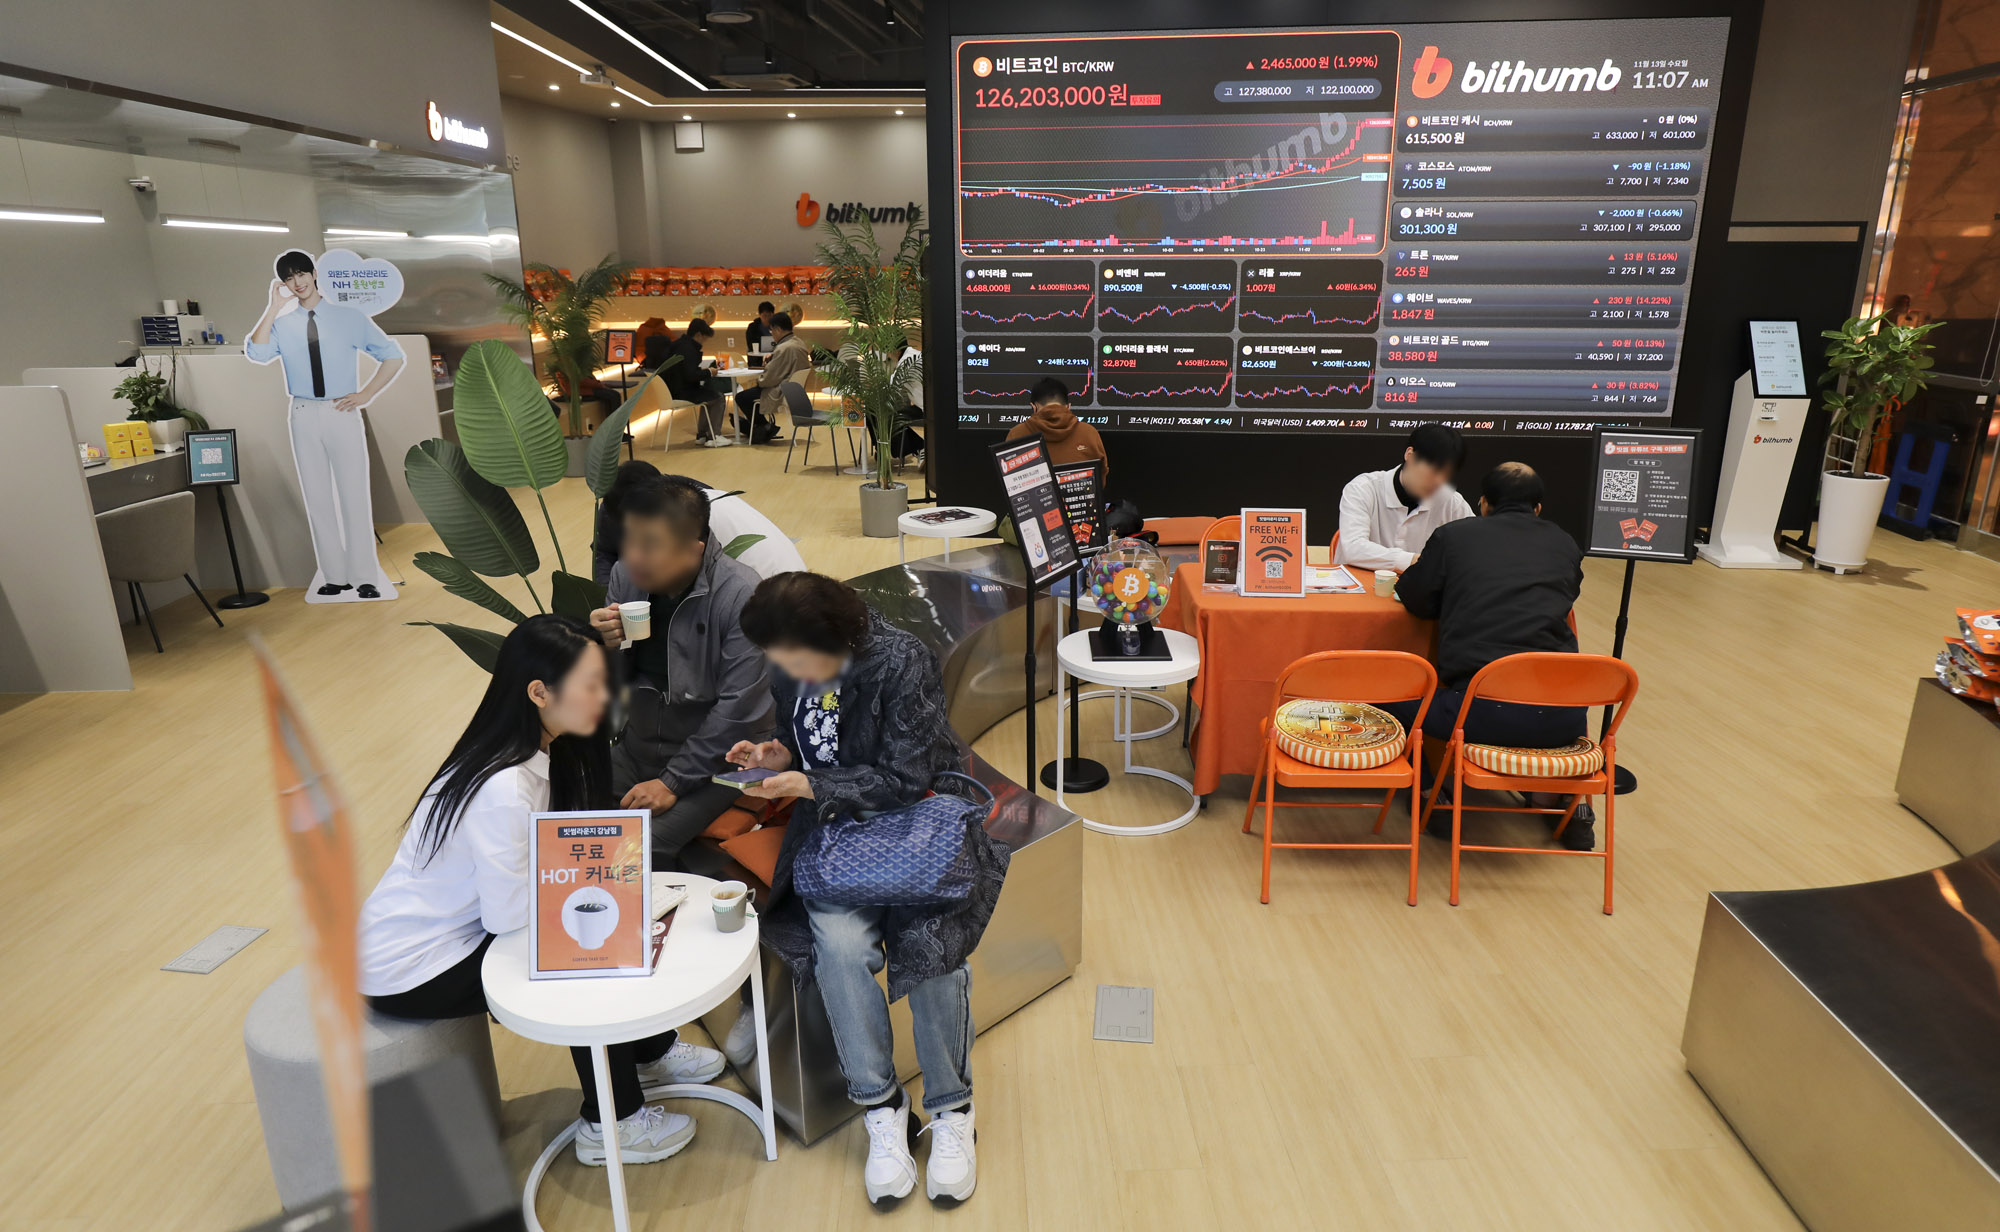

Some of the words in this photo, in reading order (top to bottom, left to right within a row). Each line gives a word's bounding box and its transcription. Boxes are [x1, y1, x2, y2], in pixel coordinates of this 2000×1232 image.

[997, 56, 1057, 75] 비트코인
[1063, 61, 1114, 73] BTC/KRW
[1261, 58, 1317, 69] 2,465,000
[1334, 55, 1378, 69] (1.99%)
[1461, 59, 1621, 93] bithumb
[1633, 72, 1689, 88] 11:07
[1692, 79, 1708, 88] AM
[1239, 87, 1291, 96] 127,380,000
[1306, 86, 1314, 95] 저
[1321, 85, 1374, 94] 122,100,000
[976, 86, 1105, 108] 126,203,000
[1422, 115, 1459, 126] 비트코인
[1461, 115, 1480, 125] 캐시
[1678, 115, 1697, 124] (0%)
[1406, 133, 1452, 144] 615,500
[1649, 131, 1657, 139] 저
[1663, 131, 1695, 139] 601,000
[1418, 162, 1454, 170] 코스모스
[1655, 162, 1690, 171] (-1.18%)
[1403, 179, 1433, 189] 7,505
[1653, 177, 1660, 185] 저
[1667, 177, 1689, 185] 7,340
[826, 202, 921, 224] bithumb
[1415, 207, 1443, 217] 솔라나
[1648, 209, 1682, 217] (-0.66%)
[1400, 224, 1445, 234] 301,300
[1410, 250, 1428, 260] 트론
[1647, 253, 1677, 261] (5.16%)
[351, 270, 388, 278] 자산관리도
[978, 269, 1007, 278] 이더리움
[1259, 268, 1274, 277] 리플
[1395, 267, 1416, 276] 265
[352, 280, 385, 289] 올원뱅크
[967, 284, 1010, 292] 4,688,000원
[1104, 284, 1142, 292] 890,500원
[1247, 284, 1275, 292] 1,007원
[1407, 293, 1433, 302] 웨이브
[1637, 296, 1671, 304] (14.22%)
[1392, 310, 1422, 319] 1,847
[1403, 335, 1438, 345] 비트코인
[1441, 336, 1458, 345] 골드
[1635, 339, 1665, 348] (0.13%)
[979, 344, 1000, 352] 에이다
[1115, 345, 1144, 353] 이더리움
[1146, 345, 1168, 353] 클래식
[1388, 352, 1425, 361] 38,580
[1242, 360, 1276, 368] 82,650원
[1400, 377, 1426, 386] 이오스
[1630, 382, 1659, 390] (3.82%)
[1385, 392, 1405, 401] 816
[1086, 417, 1108, 425] 11.12)
[1150, 417, 1175, 425] [KQ11]
[1474, 421, 1495, 430] 0.08)
[1523, 422, 1552, 430] [GOLD]
[1250, 526, 1271, 534] FREE
[1275, 526, 1298, 534] Wi-Fi
[1260, 536, 1287, 544] ZONE
[563, 827, 596, 836] 빗썸라운지
[597, 826, 617, 834] 강남점
[569, 843, 605, 862] 무료
[541, 868, 579, 884] HOT
[586, 864, 640, 884] 커피존
